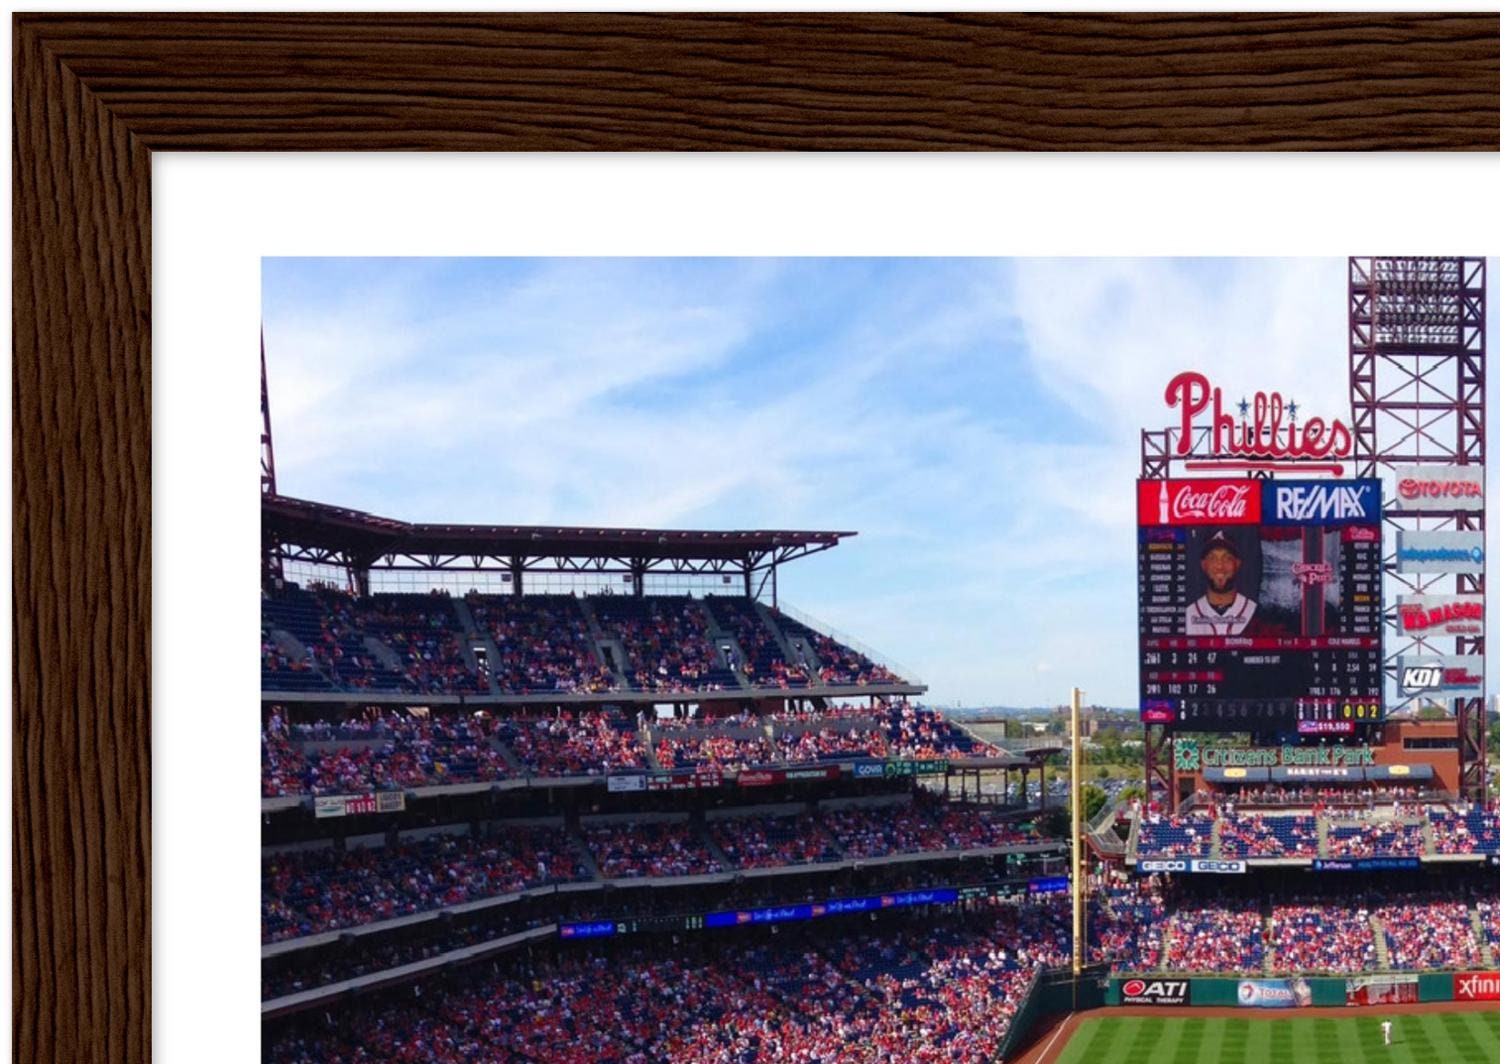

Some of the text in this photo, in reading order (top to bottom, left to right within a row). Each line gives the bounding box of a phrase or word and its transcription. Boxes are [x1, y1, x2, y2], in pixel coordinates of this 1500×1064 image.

[1165, 372, 1351, 458] Phillies
[1417, 479, 1482, 498] TOYOTA
[1173, 484, 1250, 519] Coca-Cola
[1276, 484, 1366, 520] RE/MAX
[1202, 744, 1375, 767] Citizens Bank Park
[1142, 860, 1186, 871] GEICO
[1198, 860, 1240, 872] GEICO
[1144, 981, 1188, 997] ATI
